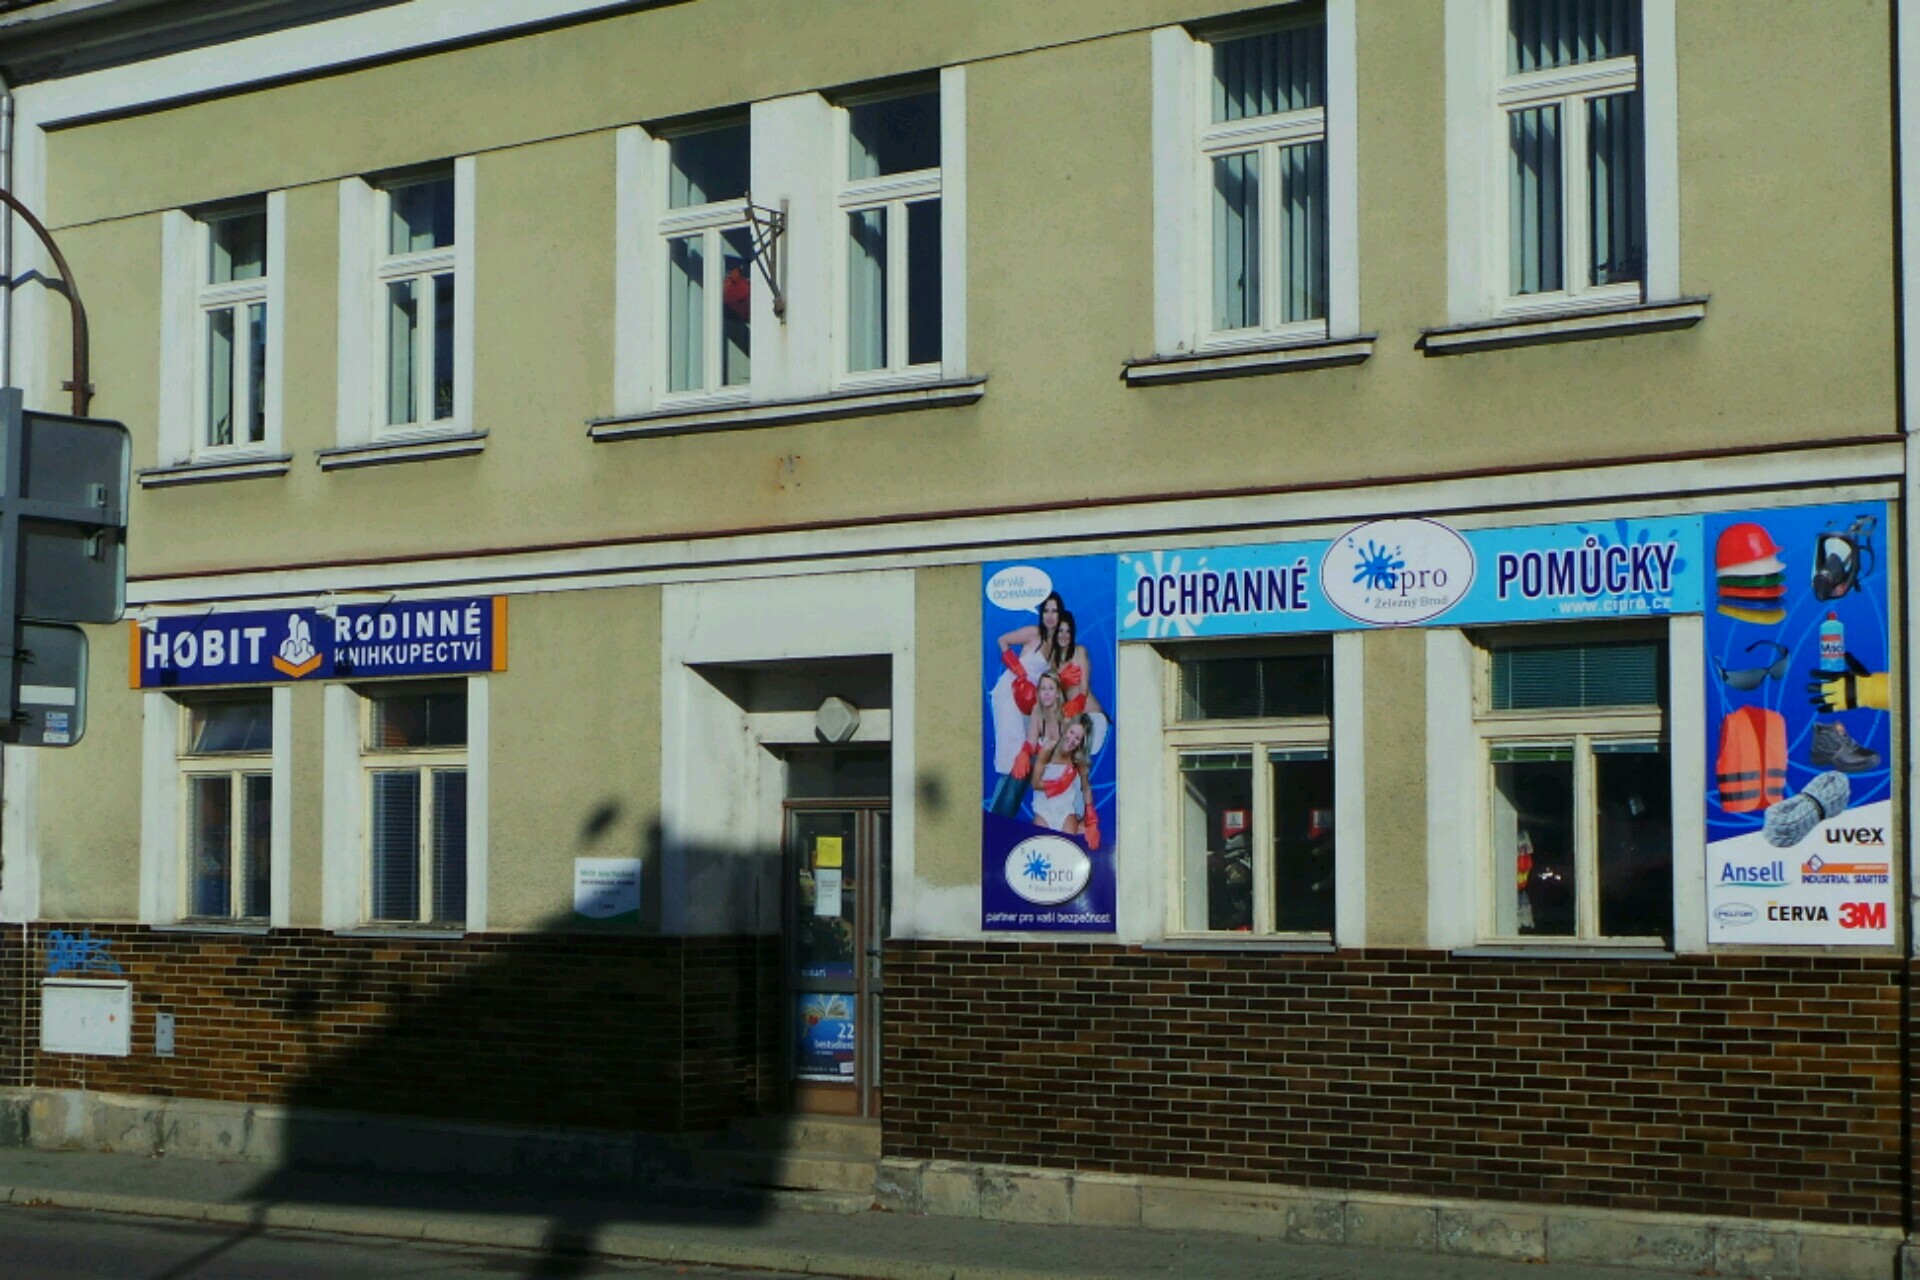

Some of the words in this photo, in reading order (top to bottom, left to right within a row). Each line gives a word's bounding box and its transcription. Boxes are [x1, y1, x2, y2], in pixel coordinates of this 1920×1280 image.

[1499, 537, 1676, 599] POMŮCKY
[1137, 559, 1308, 617] OCHRANNÉ
[335, 602, 481, 643] RODINNÉ
[146, 627, 267, 669] HOBIT
[334, 635, 481, 667] KNIHKUPECTVÍ
[1826, 827, 1884, 844] uvex
[1721, 861, 1784, 881] Ansell
[1767, 906, 1828, 921] CERVA
[1838, 902, 1887, 929] 3M
[838, 1022, 854, 1039] 22
